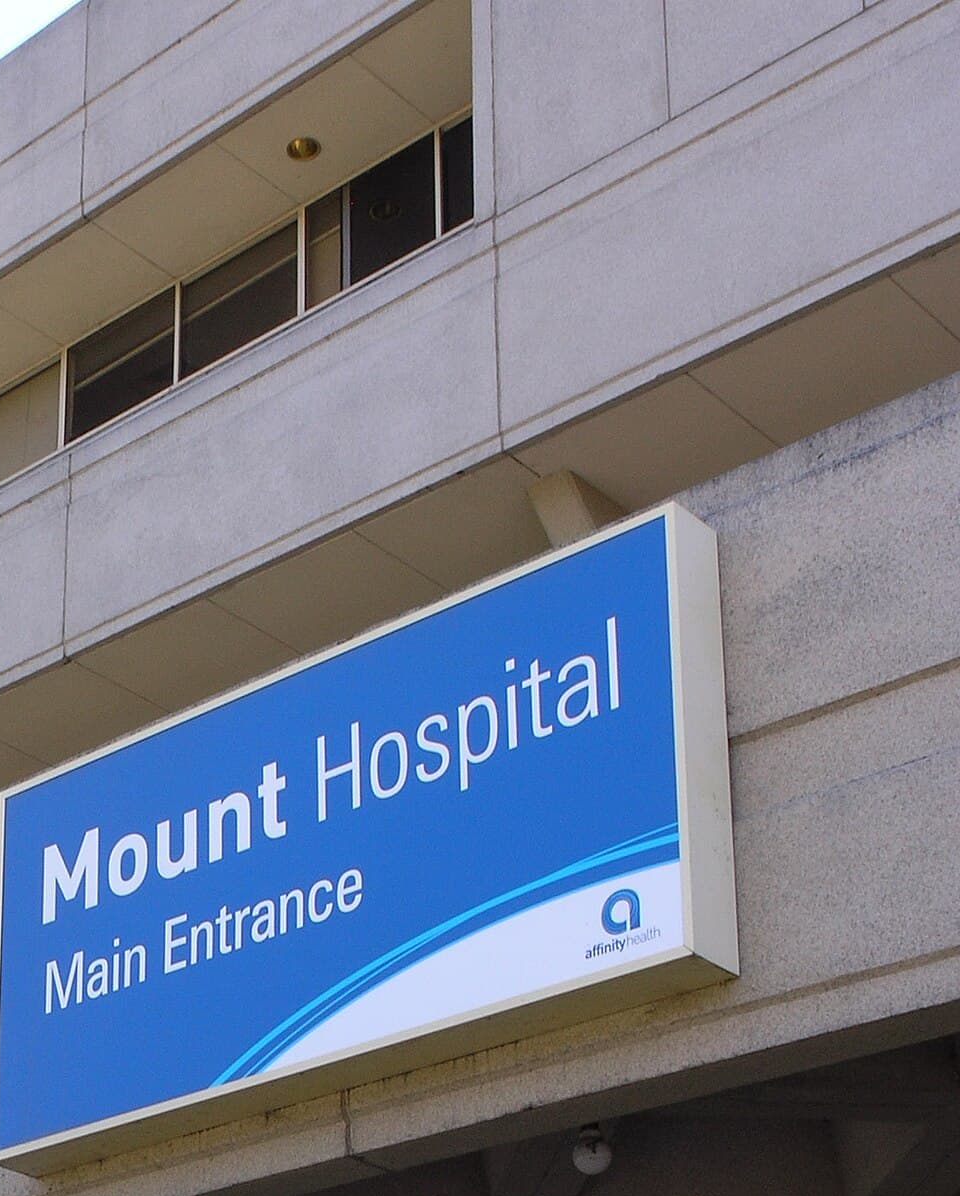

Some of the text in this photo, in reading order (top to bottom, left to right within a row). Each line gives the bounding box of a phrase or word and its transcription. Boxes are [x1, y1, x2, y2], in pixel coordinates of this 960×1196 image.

[42, 616, 621, 925] Mount Hospital
[43, 866, 364, 1015] Main Entrance
